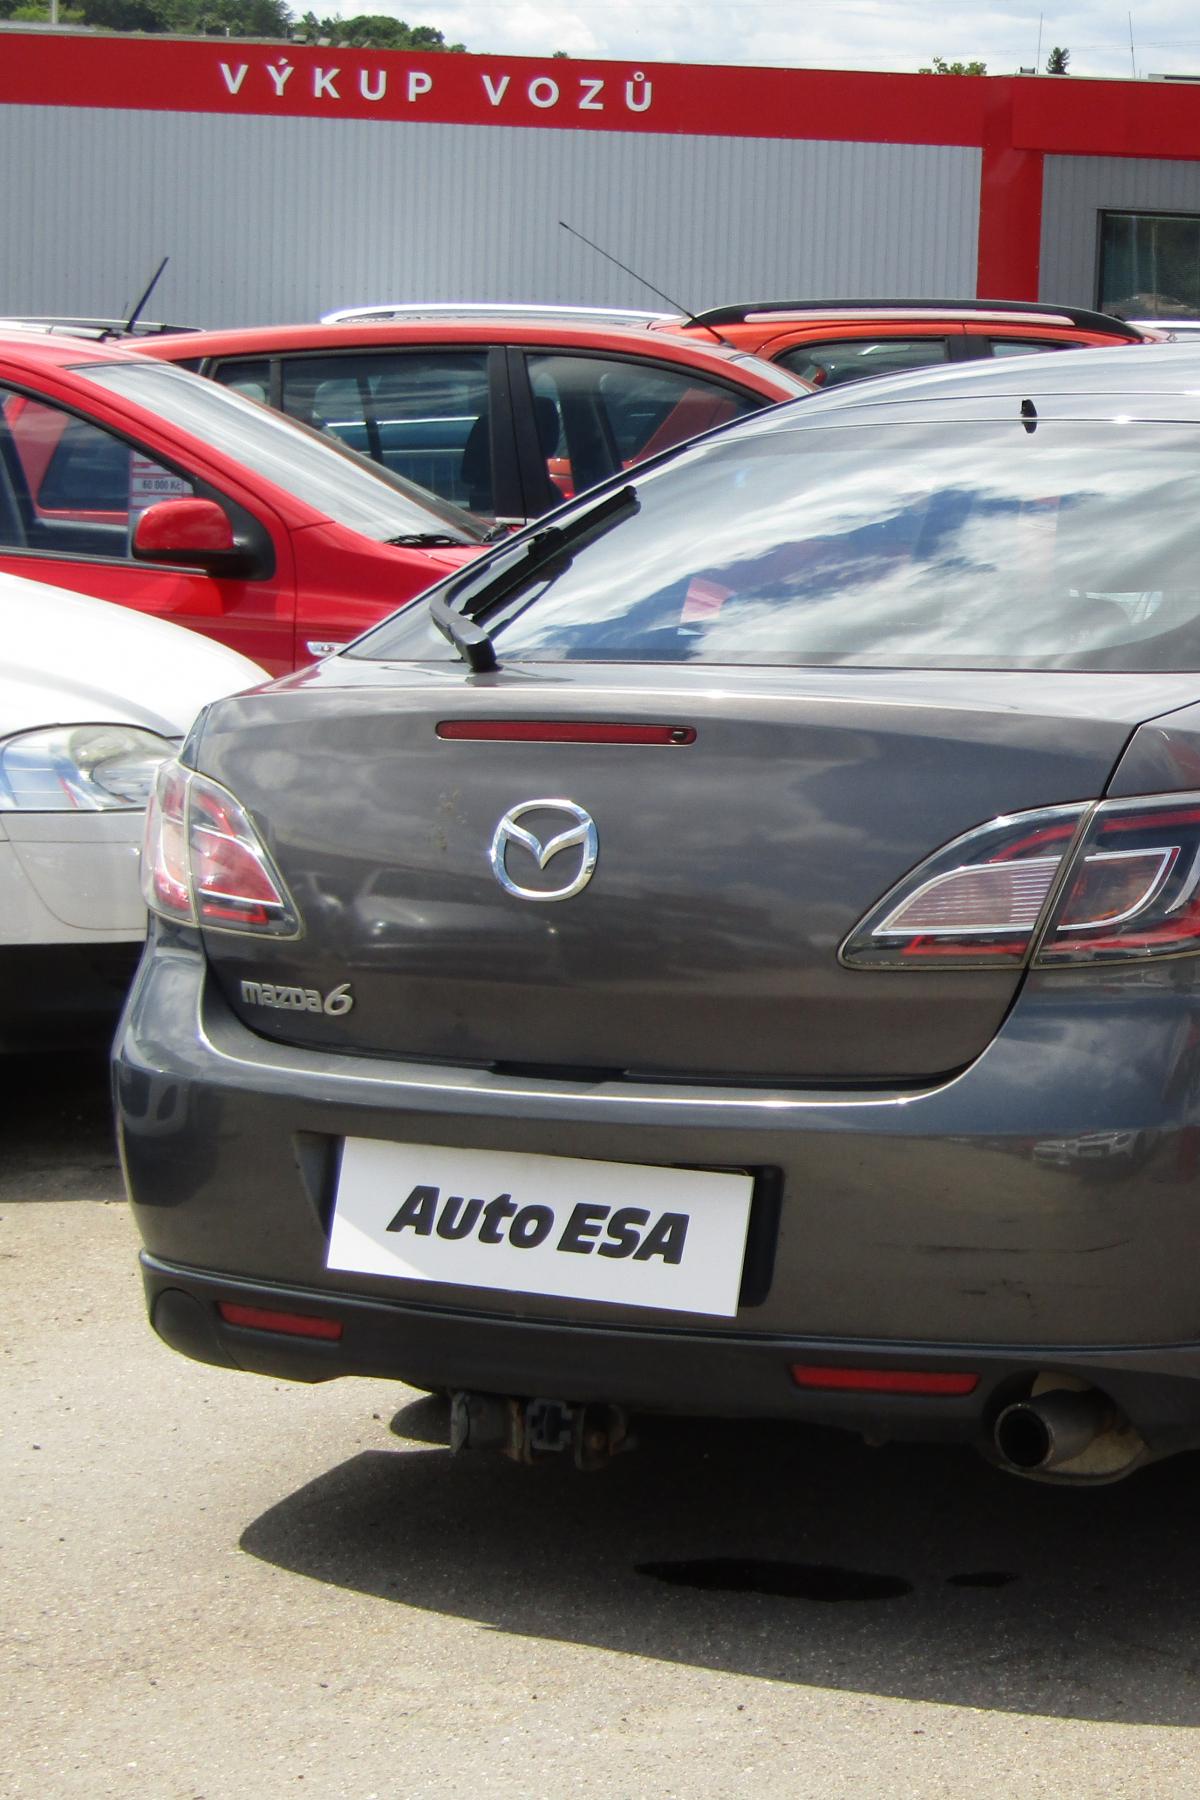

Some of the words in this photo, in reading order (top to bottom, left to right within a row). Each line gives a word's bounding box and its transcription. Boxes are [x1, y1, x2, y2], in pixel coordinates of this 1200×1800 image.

[220, 57, 433, 102] VÝKUP
[481, 71, 653, 112] VOZŮ
[385, 1184, 555, 1249] Auto
[556, 1202, 690, 1265] ESA
